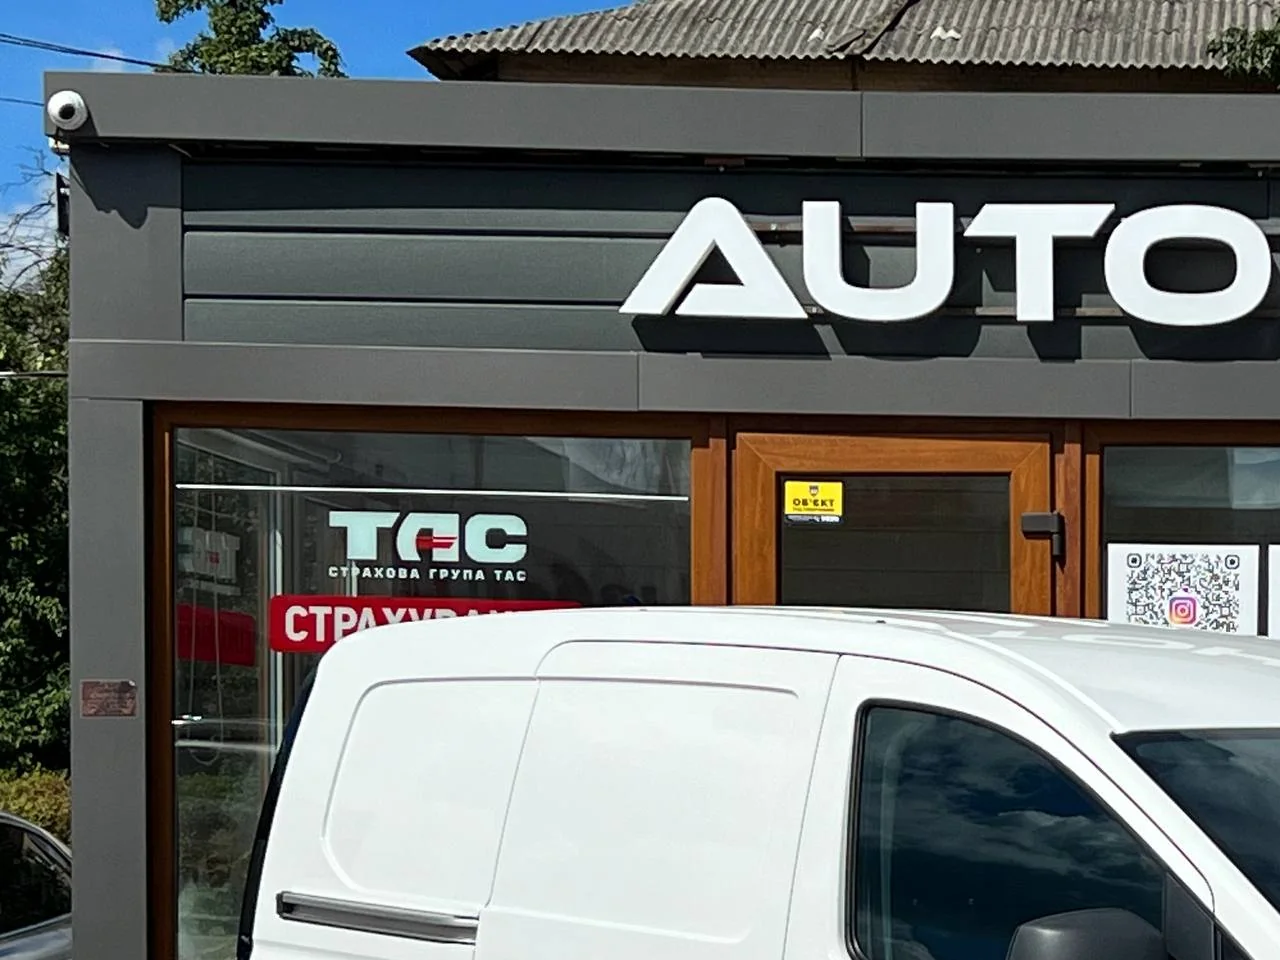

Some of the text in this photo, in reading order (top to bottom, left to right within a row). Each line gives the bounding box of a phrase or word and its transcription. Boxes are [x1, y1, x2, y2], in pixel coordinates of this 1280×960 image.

[328, 510, 528, 564] ТАС
[328, 566, 527, 582] СТРАХОВА ГРУПА ТАС
